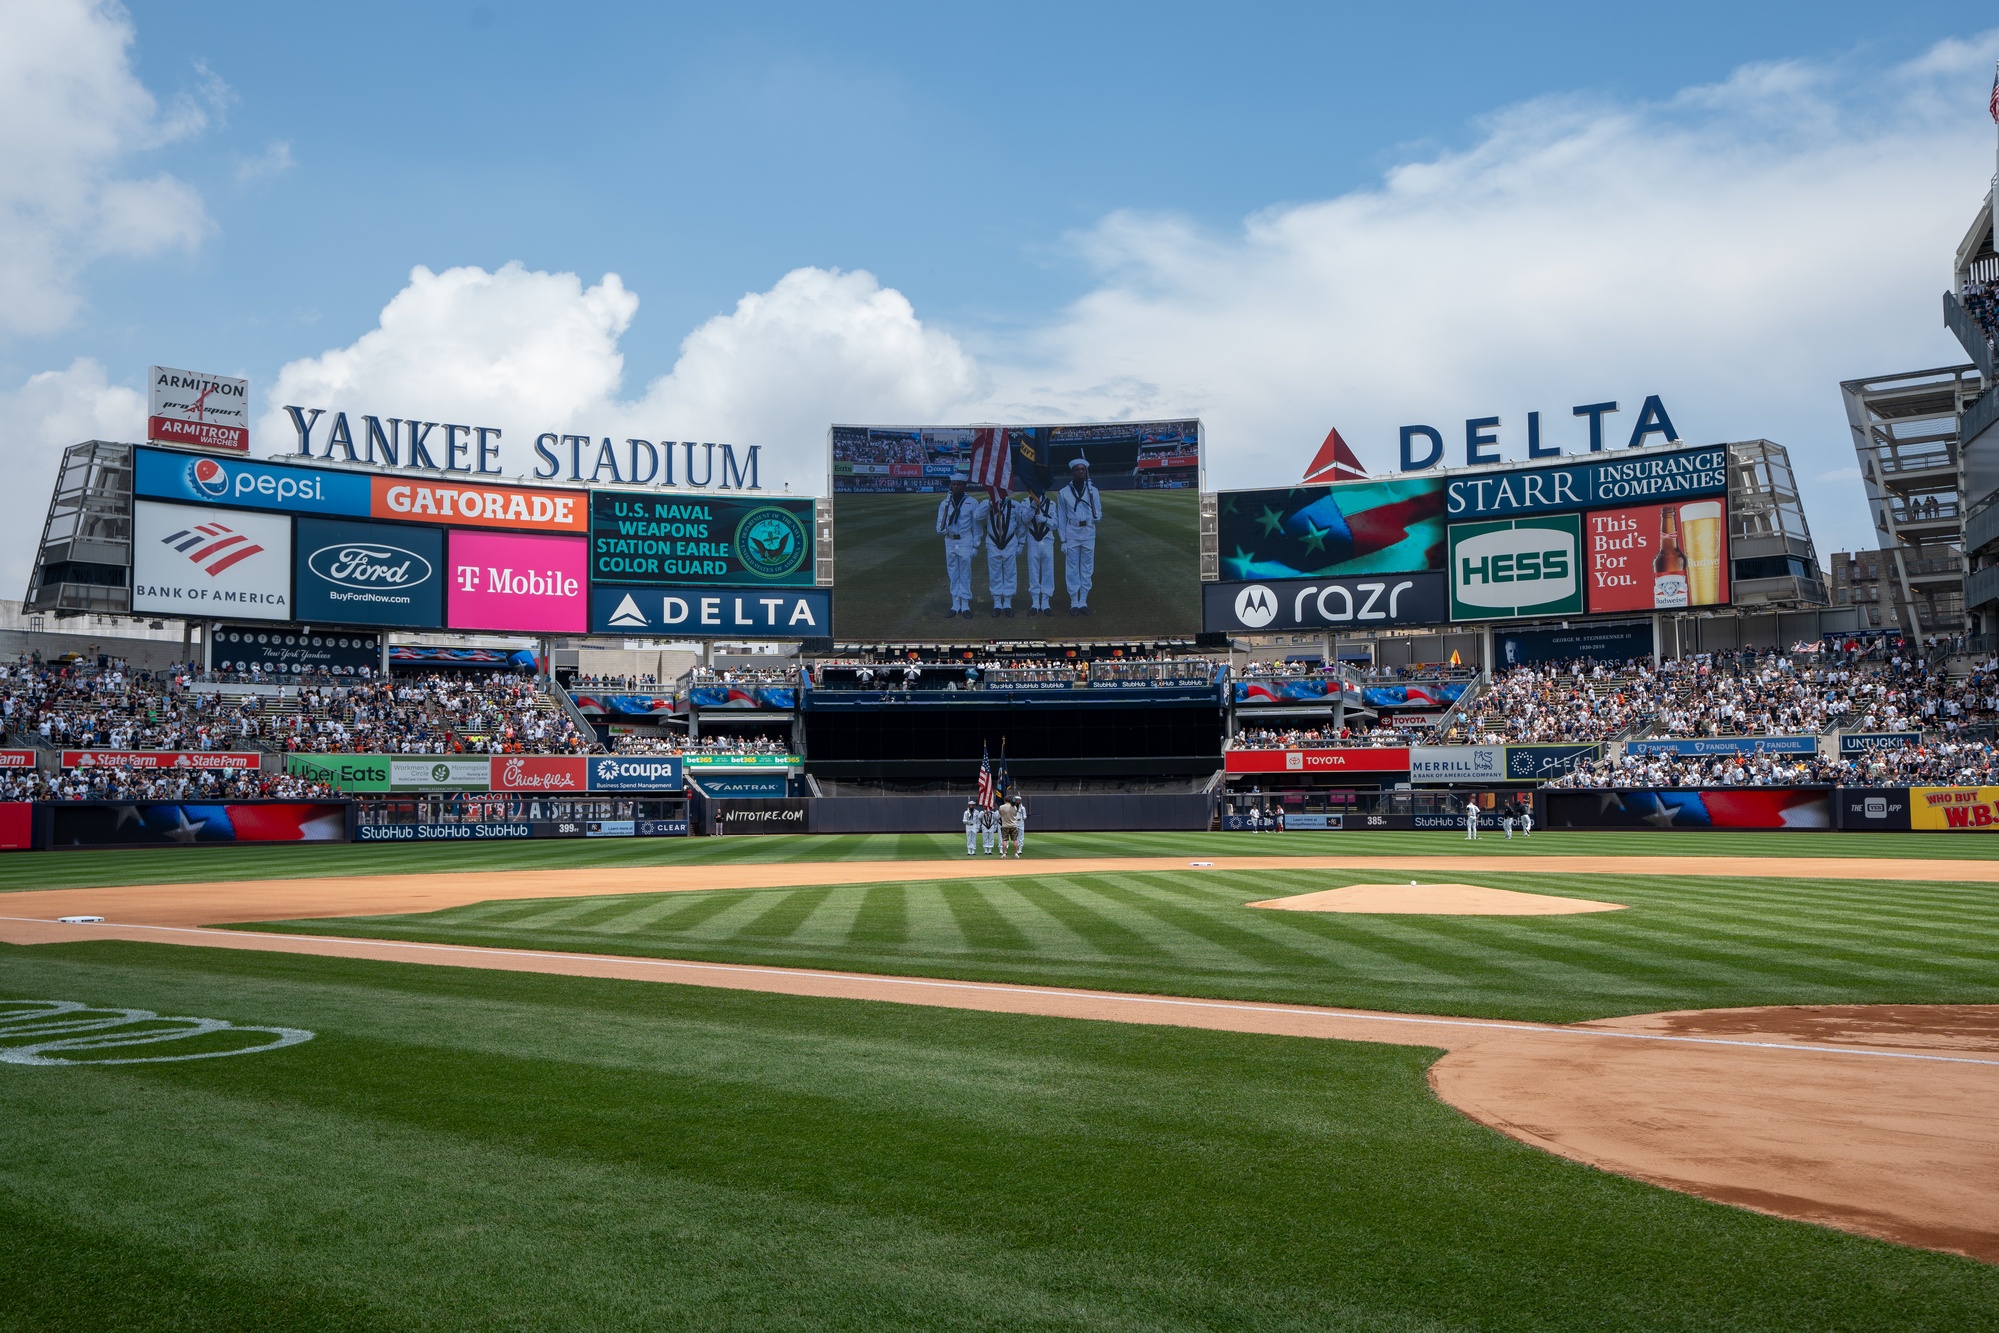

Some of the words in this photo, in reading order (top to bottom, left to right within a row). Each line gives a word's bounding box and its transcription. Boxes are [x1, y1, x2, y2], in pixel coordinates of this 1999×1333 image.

[157, 374, 244, 397] ARMITRON
[161, 421, 239, 440] ARMITRON
[1399, 394, 1681, 473] DELTA
[200, 436, 238, 447] WATCHES
[282, 404, 502, 476] YANKEE
[532, 432, 762, 491] STADIUM
[1599, 451, 1726, 483] INSURANCE
[235, 472, 322, 502] pepsi
[1447, 471, 1583, 513] STARR
[1598, 469, 1726, 499] COMPANIES
[386, 485, 574, 524] GATORADE
[614, 502, 649, 518] U.S.
[655, 504, 713, 520] NAVAL
[618, 521, 708, 539] WEAPONS
[742, 513, 770, 539] DEPARTMENT
[782, 515, 793, 526] THE
[791, 524, 801, 539] NAVY
[1592, 514, 1637, 533] This
[597, 538, 671, 556] STATION
[676, 541, 729, 557] EARLE
[1594, 531, 1647, 552] Bud's
[330, 547, 411, 583] Ford
[599, 556, 659, 574] COLOR
[664, 559, 727, 576] GUARD
[741, 545, 754, 565] UNITED
[754, 562, 774, 573] STATES
[784, 547, 801, 569] AMERICA
[1462, 549, 1569, 586] HESS
[1594, 552, 1627, 570] For
[487, 567, 579, 597] Mobile
[1595, 572, 1637, 588] You.
[136, 584, 183, 599] BANK
[187, 588, 209, 600] OF
[212, 589, 287, 606] AMERICA
[330, 590, 410, 604] BuyFordNow.com
[1294, 580, 1413, 623] razr
[663, 596, 816, 626] DELTA
[1583, 634, 1625, 642] STEINBRENNER
[261, 646, 280, 657] New
[280, 648, 300, 662] York
[300, 649, 331, 662] Yankees
[1122, 680, 1146, 688] StubHub
[1178, 679, 1203, 687] StubHub
[1393, 716, 1427, 724] TOYOTA
[1766, 741, 1801, 749] FANDUEL
[451, 764, 488, 772] Morningside
[1305, 756, 1346, 765] TOYOTA
[1412, 761, 1471, 771] MERRILL
[341, 765, 386, 782] Eats
[503, 760, 574, 789] Chick-fil-A
[620, 763, 672, 780] coupa
[1925, 793, 1953, 805] WHO
[1954, 791, 1978, 803] BUT
[725, 809, 804, 822] NITTOTIRE.COM
[1851, 803, 1863, 812] THE
[1887, 804, 1902, 812] APP
[361, 825, 414, 839] StubHub
[418, 824, 470, 838] StubHub
[475, 823, 528, 837] StubHub
[1246, 818, 1274, 826] CER
[1414, 817, 1454, 827] StubHub
[1456, 817, 1494, 827] StHub
